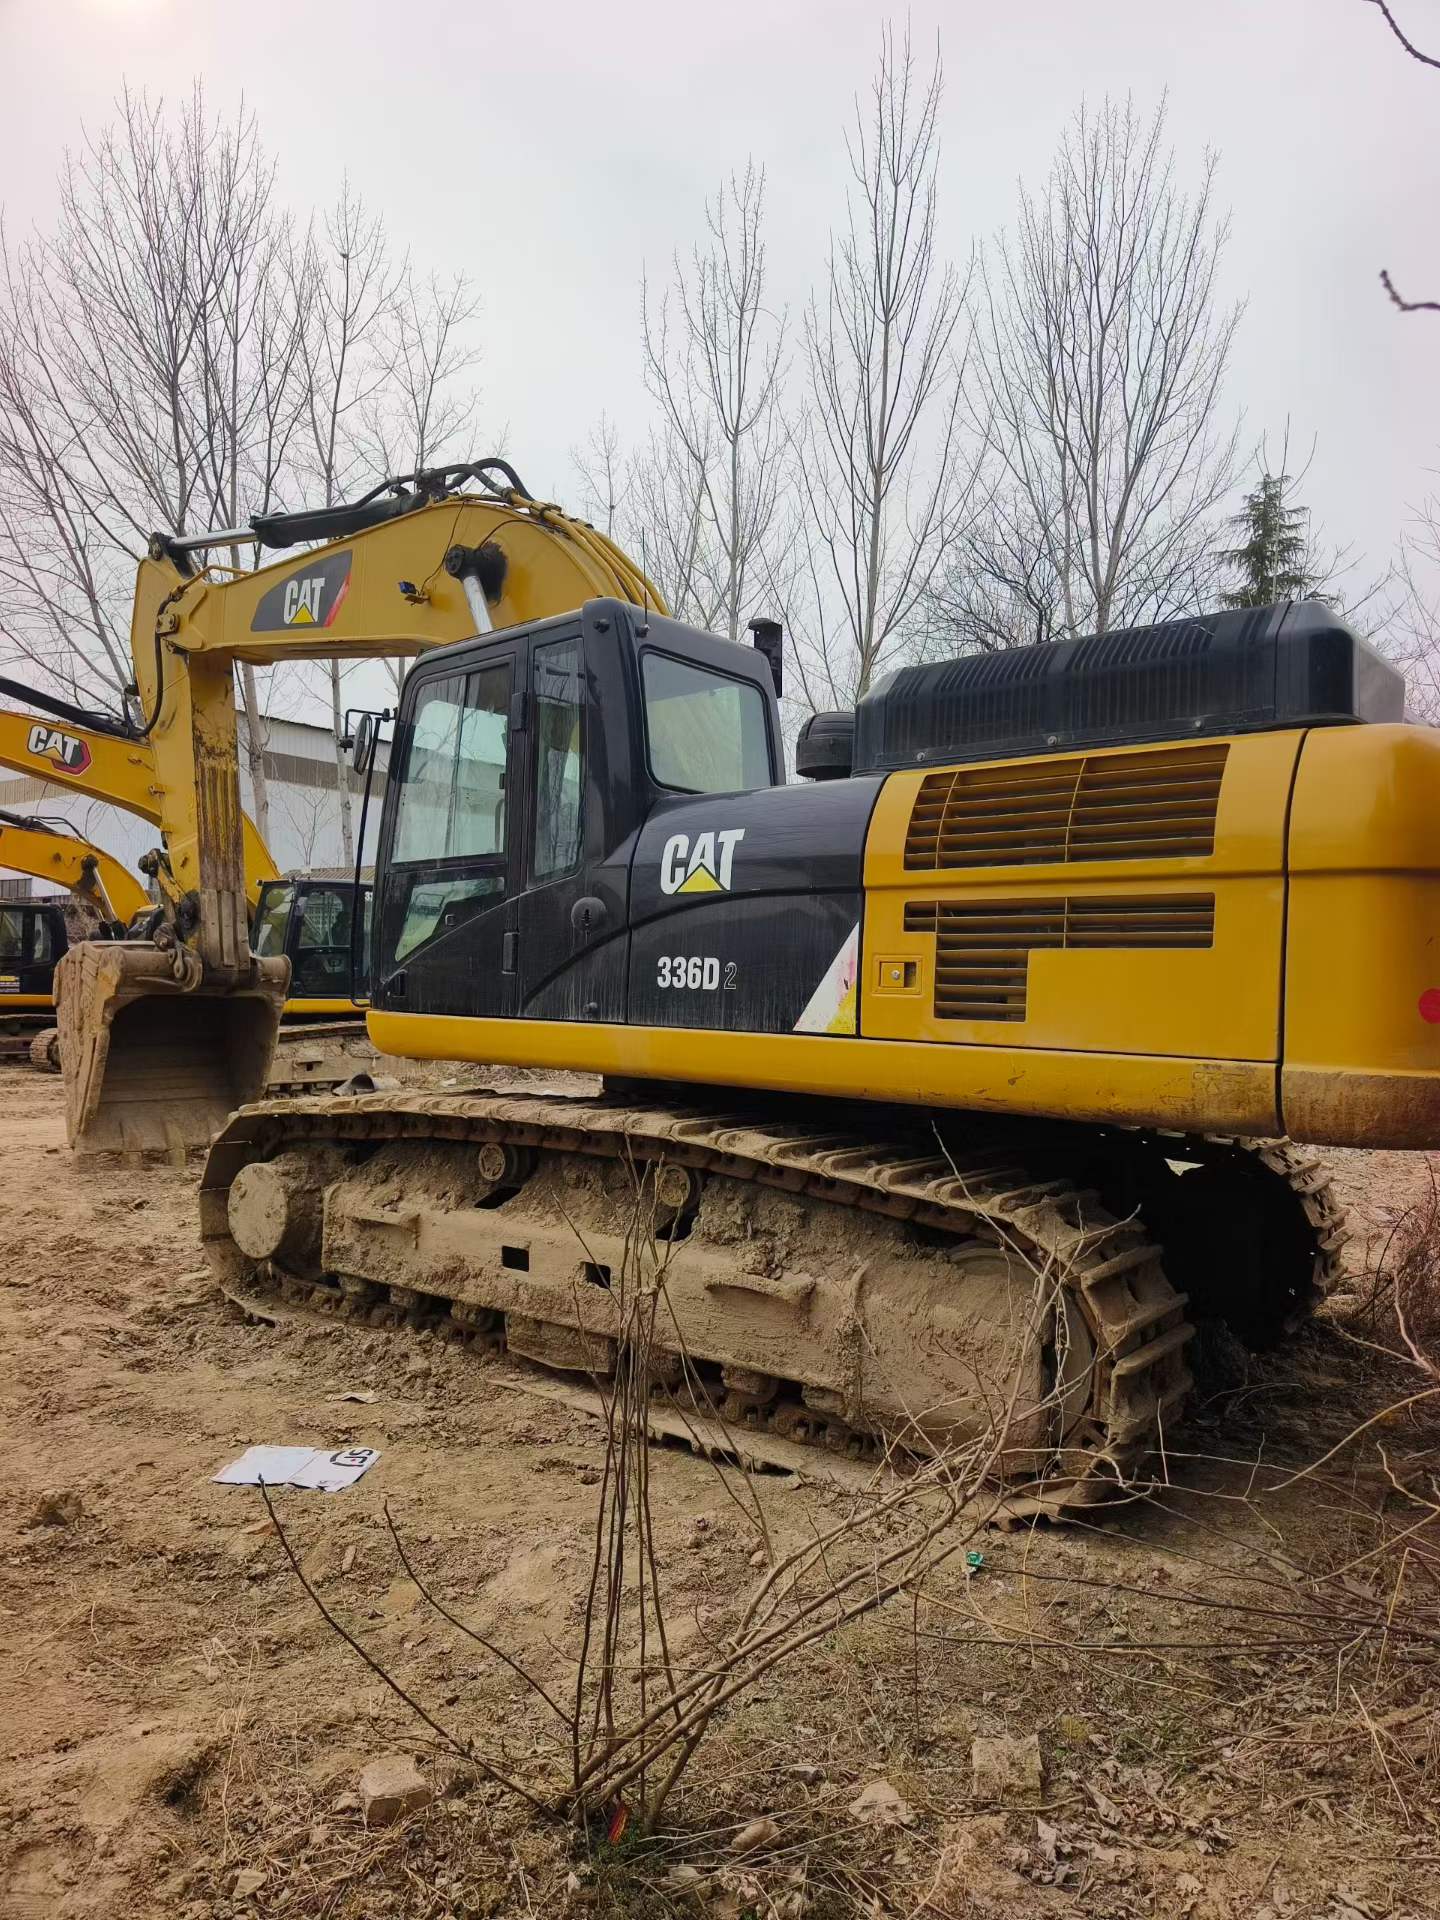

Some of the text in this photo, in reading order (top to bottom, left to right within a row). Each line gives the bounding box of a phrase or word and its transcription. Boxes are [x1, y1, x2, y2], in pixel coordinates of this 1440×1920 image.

[283, 577, 325, 624] CAT
[28, 725, 79, 764] CAT
[660, 828, 745, 895] CAT
